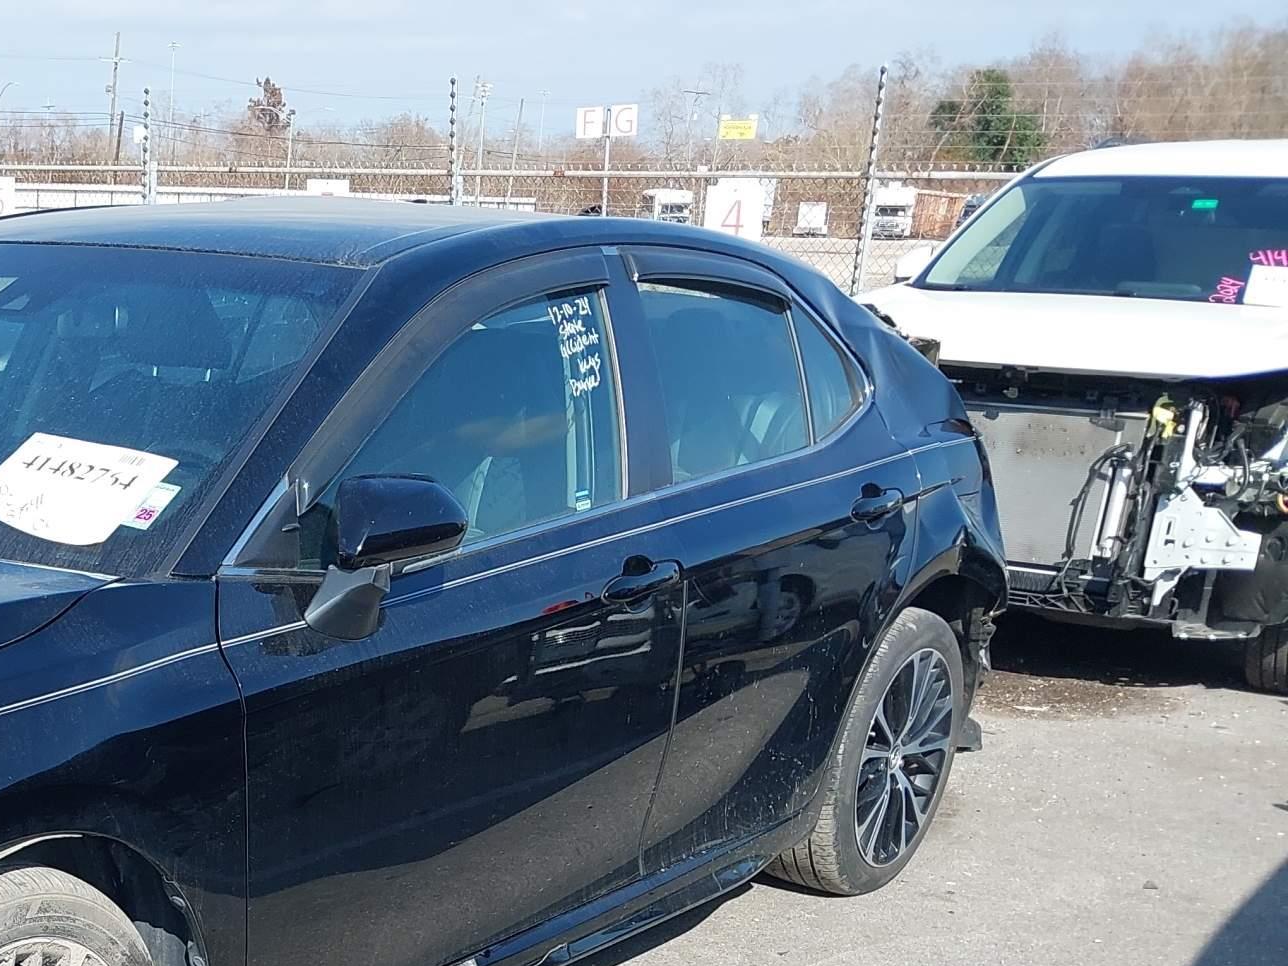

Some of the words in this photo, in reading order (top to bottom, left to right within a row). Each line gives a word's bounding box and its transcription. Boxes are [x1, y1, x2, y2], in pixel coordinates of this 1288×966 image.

[583, 109, 596, 136] F
[615, 107, 633, 134] G
[721, 199, 745, 236] 4
[136, 508, 155, 522] 25
